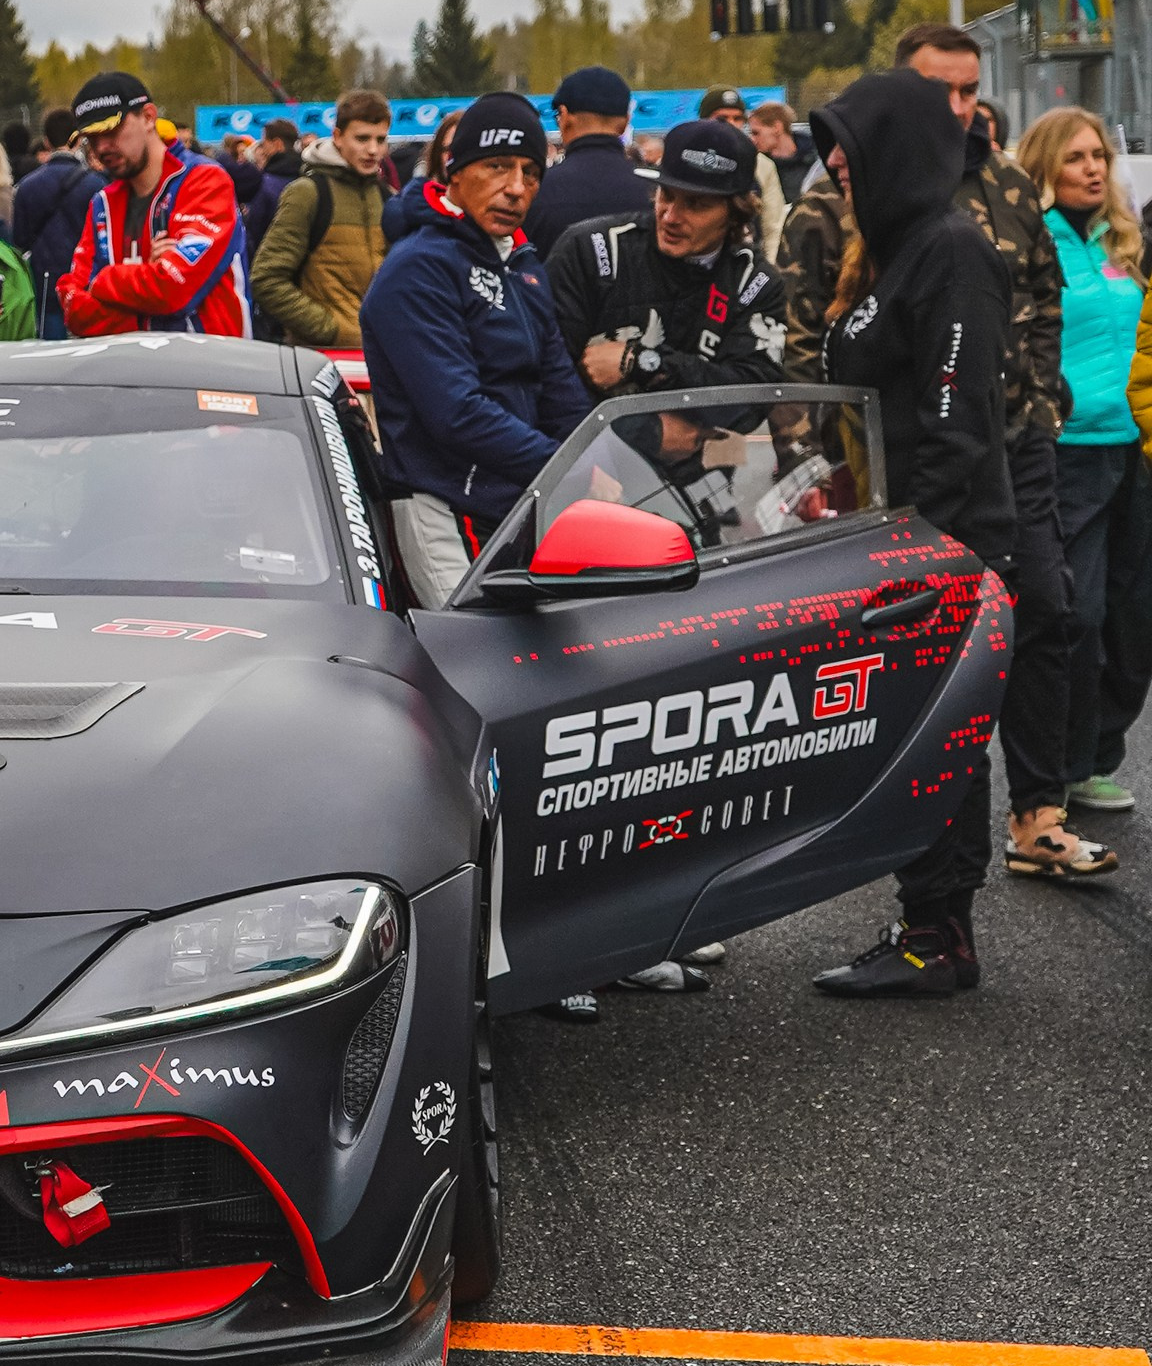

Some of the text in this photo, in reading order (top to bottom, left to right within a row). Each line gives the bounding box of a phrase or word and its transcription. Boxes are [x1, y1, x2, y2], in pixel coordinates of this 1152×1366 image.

[479, 129, 525, 148] UFC
[543, 653, 884, 780] SPORA GT
[536, 718, 877, 817] СПОРТИВНЫЕ АВТОМОБИЛИ
[533, 785, 795, 877] НЕФРО СОВЕТ
[422, 1101, 448, 1122] SPORA
